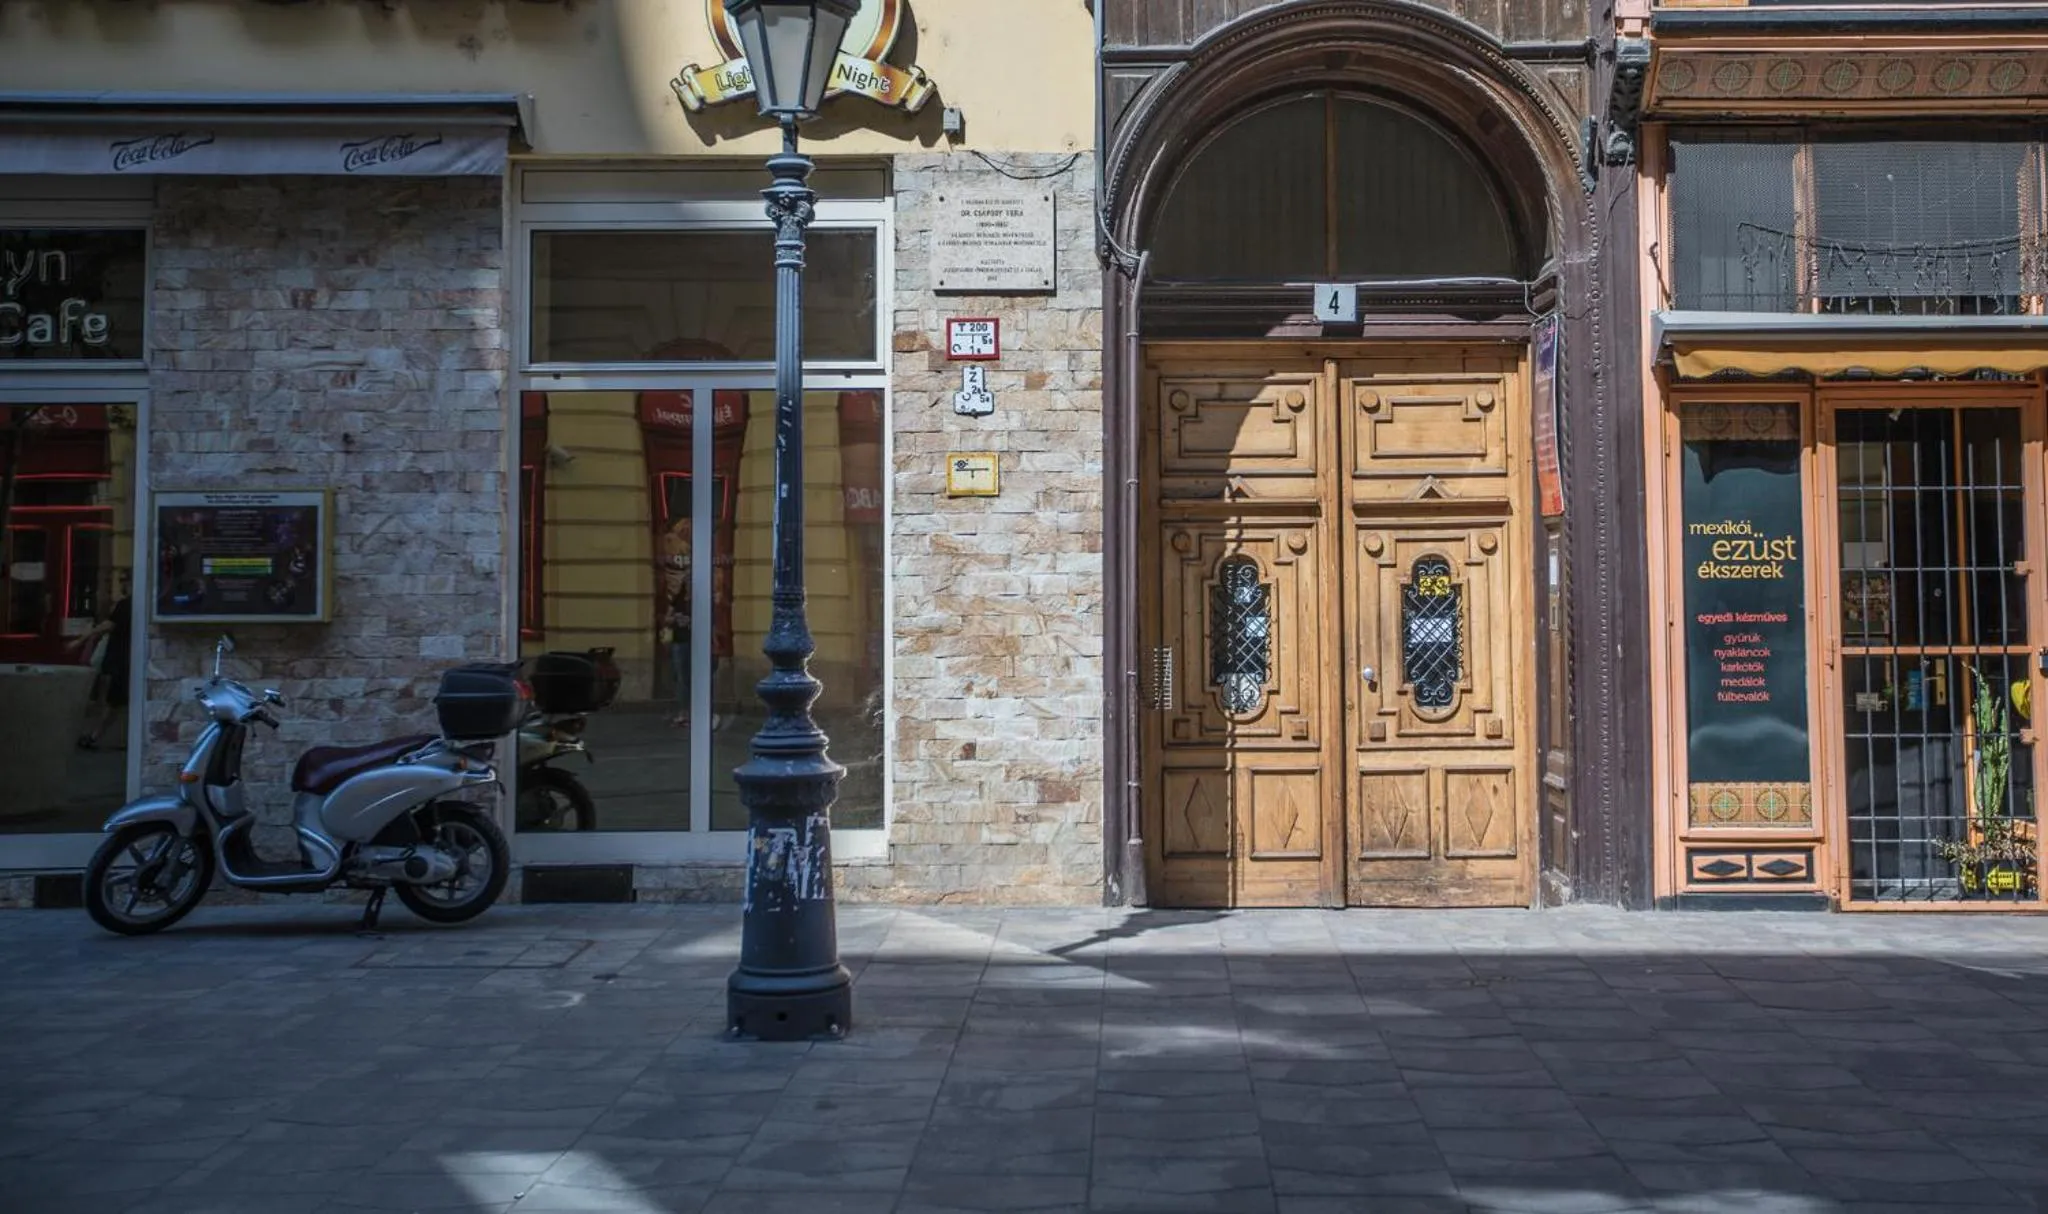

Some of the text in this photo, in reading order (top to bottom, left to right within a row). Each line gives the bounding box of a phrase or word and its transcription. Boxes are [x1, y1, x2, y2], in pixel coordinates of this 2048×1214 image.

[715, 62, 890, 92] Lig Night
[0, 249, 67, 295] yn
[1329, 291, 1339, 314] 4
[0, 298, 109, 345] Cafe
[958, 323, 988, 332] T 200
[969, 372, 977, 383] Z
[1689, 520, 1753, 535] mexikói
[1712, 532, 1797, 561] ezüst
[1697, 561, 1784, 579] ékszerek
[1697, 611, 1733, 624] egyedi
